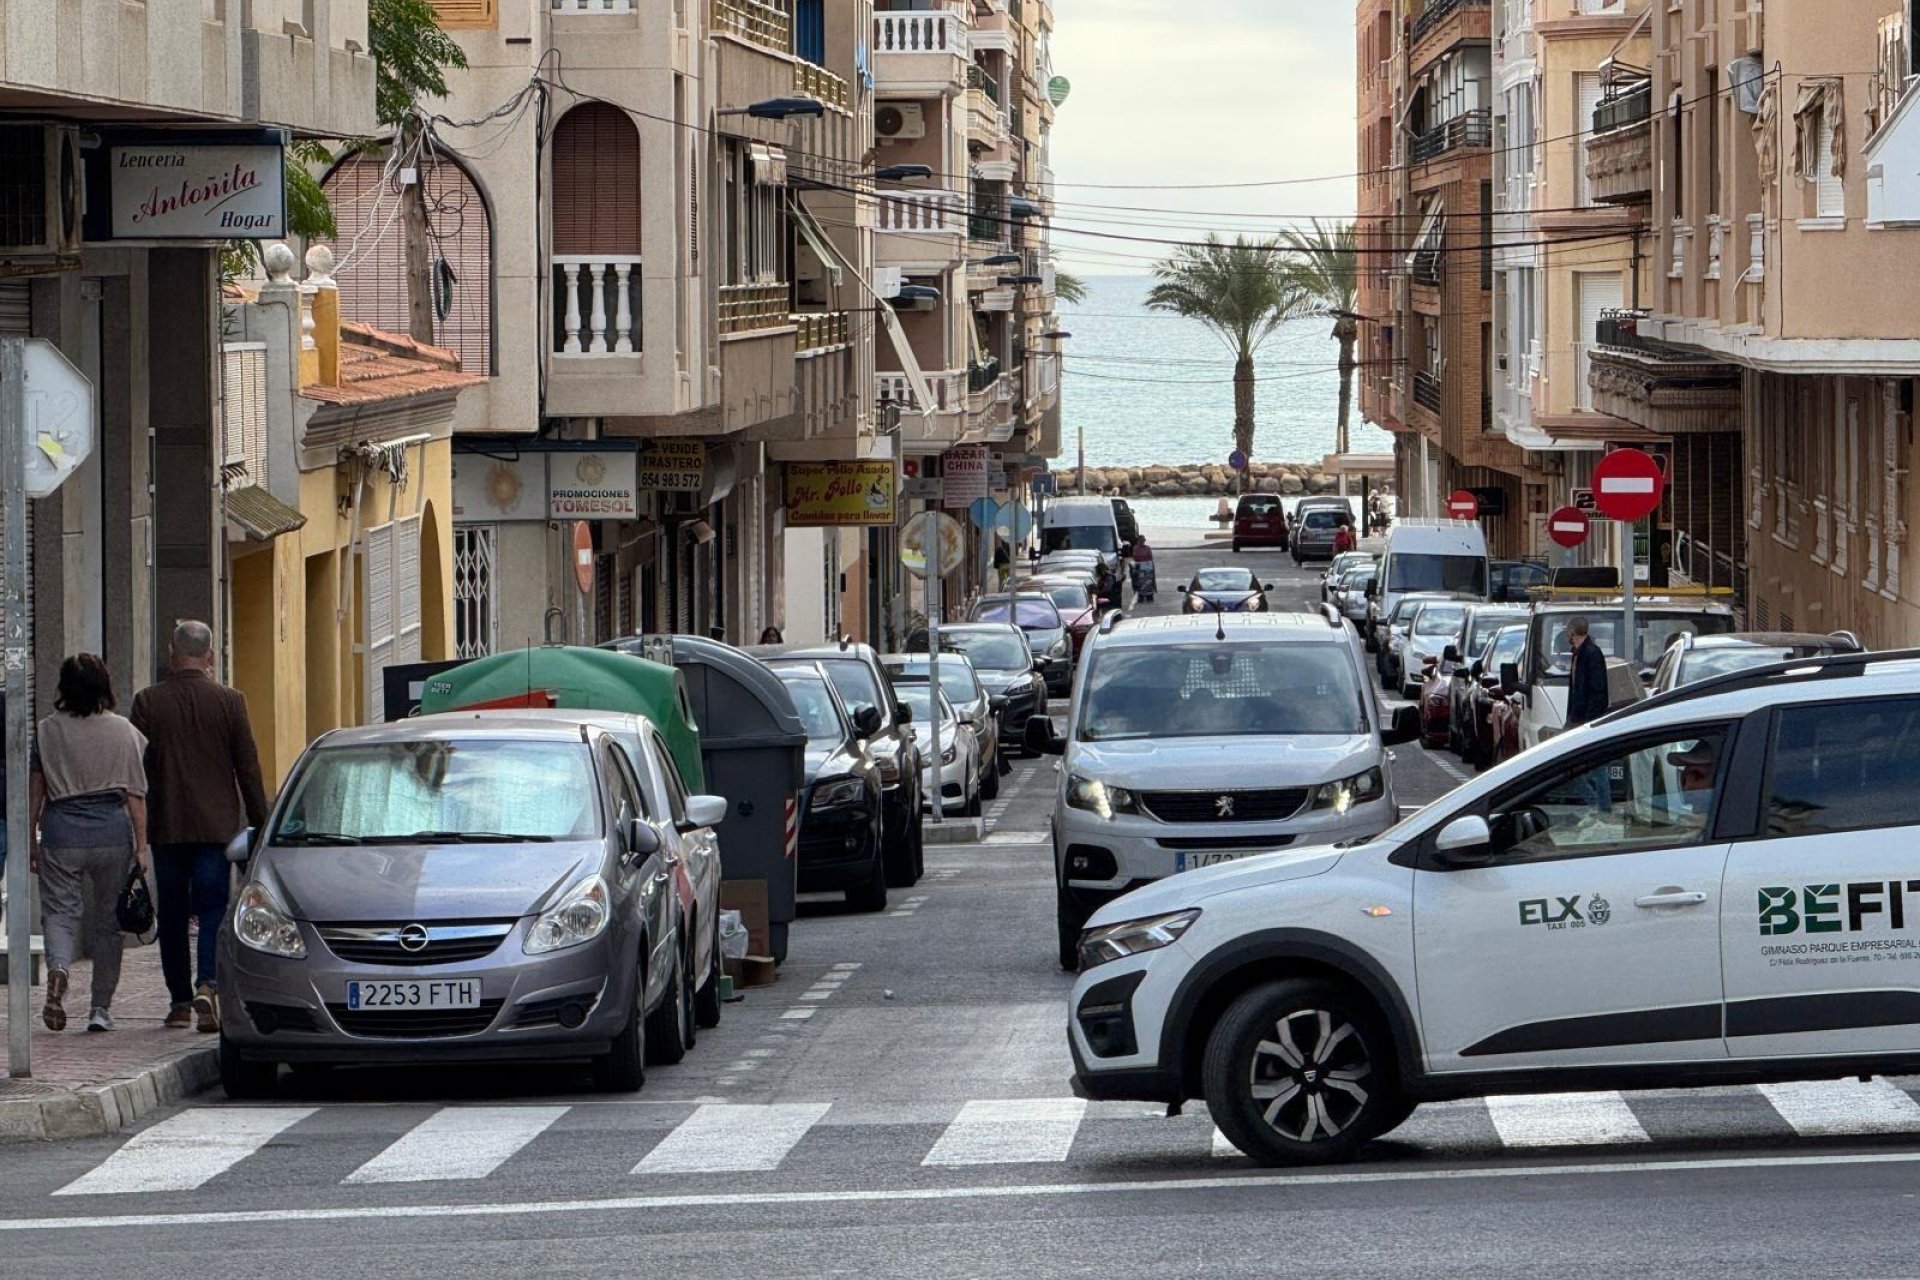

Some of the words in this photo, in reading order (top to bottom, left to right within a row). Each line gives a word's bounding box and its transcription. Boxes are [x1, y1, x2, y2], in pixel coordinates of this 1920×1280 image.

[132, 163, 256, 223] Antoñita
[220, 211, 275, 230] Hogar
[662, 443, 699, 455] VENDE
[642, 456, 702, 469] TRASTERO
[947, 460, 984, 471] CHINA
[857, 464, 890, 475] Asado
[641, 471, 660, 486] 654
[662, 472, 680, 487] 983
[682, 473, 700, 487] 572
[552, 489, 631, 499] PROMOCIONES
[824, 477, 863, 502] Pollo
[552, 500, 635, 513] TOMESOL
[863, 510, 891, 520] llevar
[1519, 895, 1584, 926] ELX
[1547, 922, 1567, 930] TAXI
[1761, 944, 1808, 956] GIMNASIO
[1810, 941, 1849, 953] PARQUE
[1851, 939, 1917, 951] EMPRESARIAL
[365, 984, 421, 1006] 2253
[429, 981, 472, 1005] FTH
